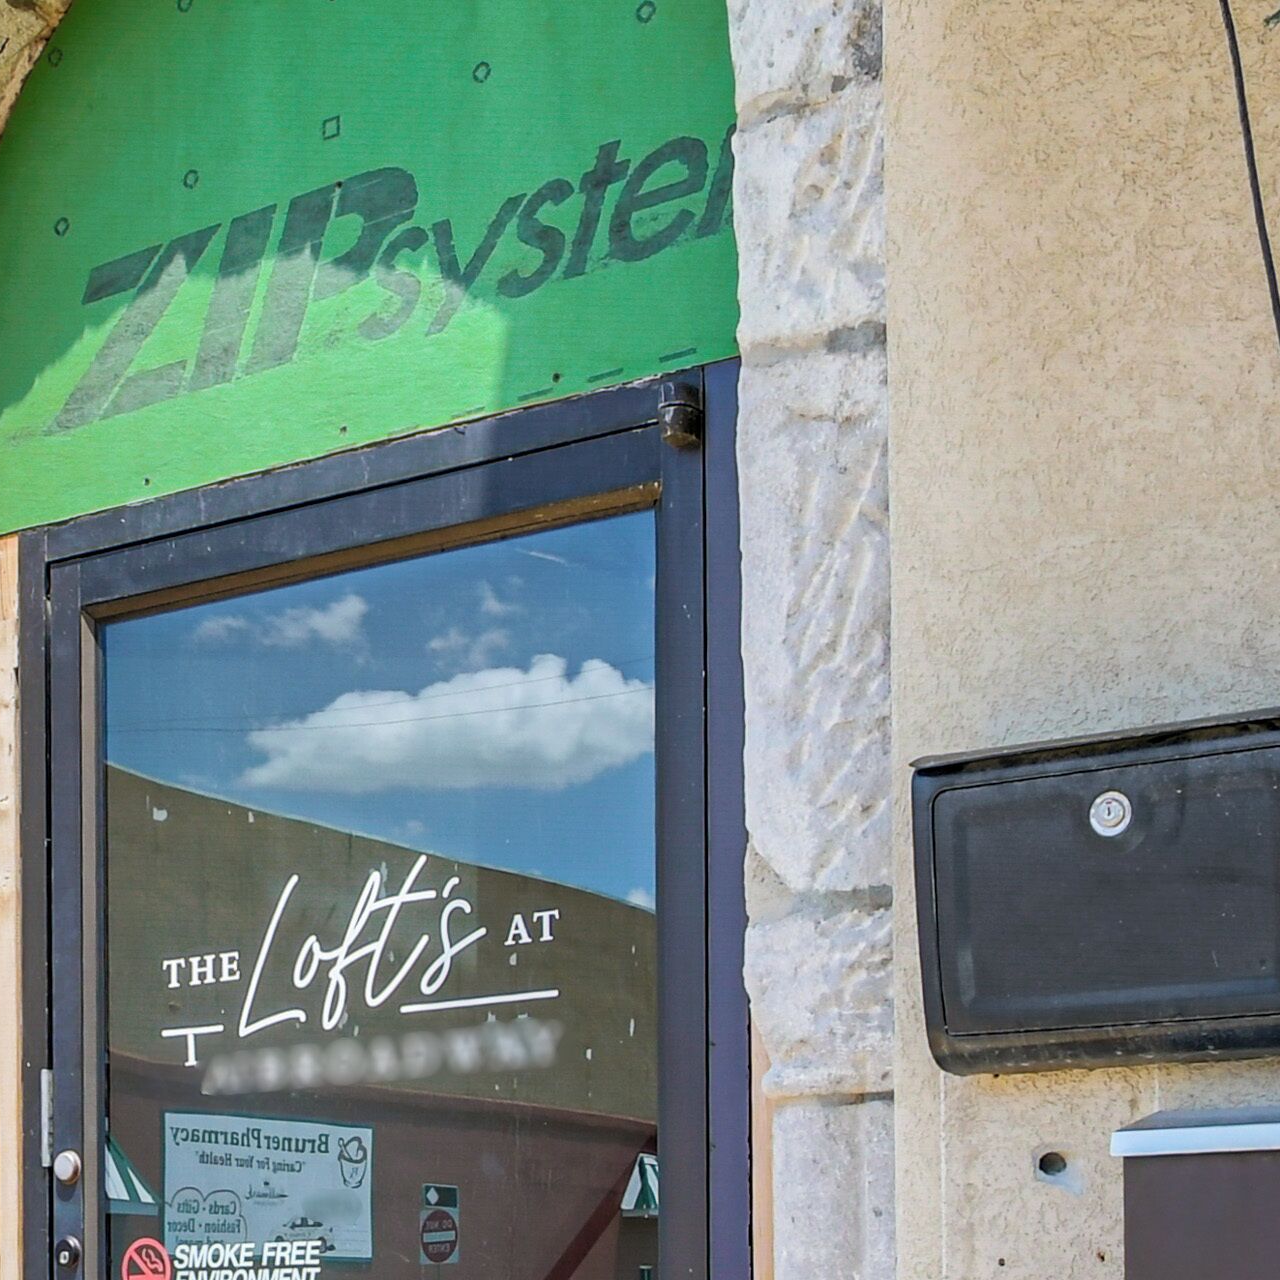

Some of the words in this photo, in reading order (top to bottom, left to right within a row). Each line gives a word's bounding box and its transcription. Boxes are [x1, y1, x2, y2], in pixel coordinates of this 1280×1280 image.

[162, 951, 241, 989] THE
[503, 909, 561, 946] AT
[173, 1242, 255, 1269] SMOKE
[261, 1240, 322, 1267] FREE
